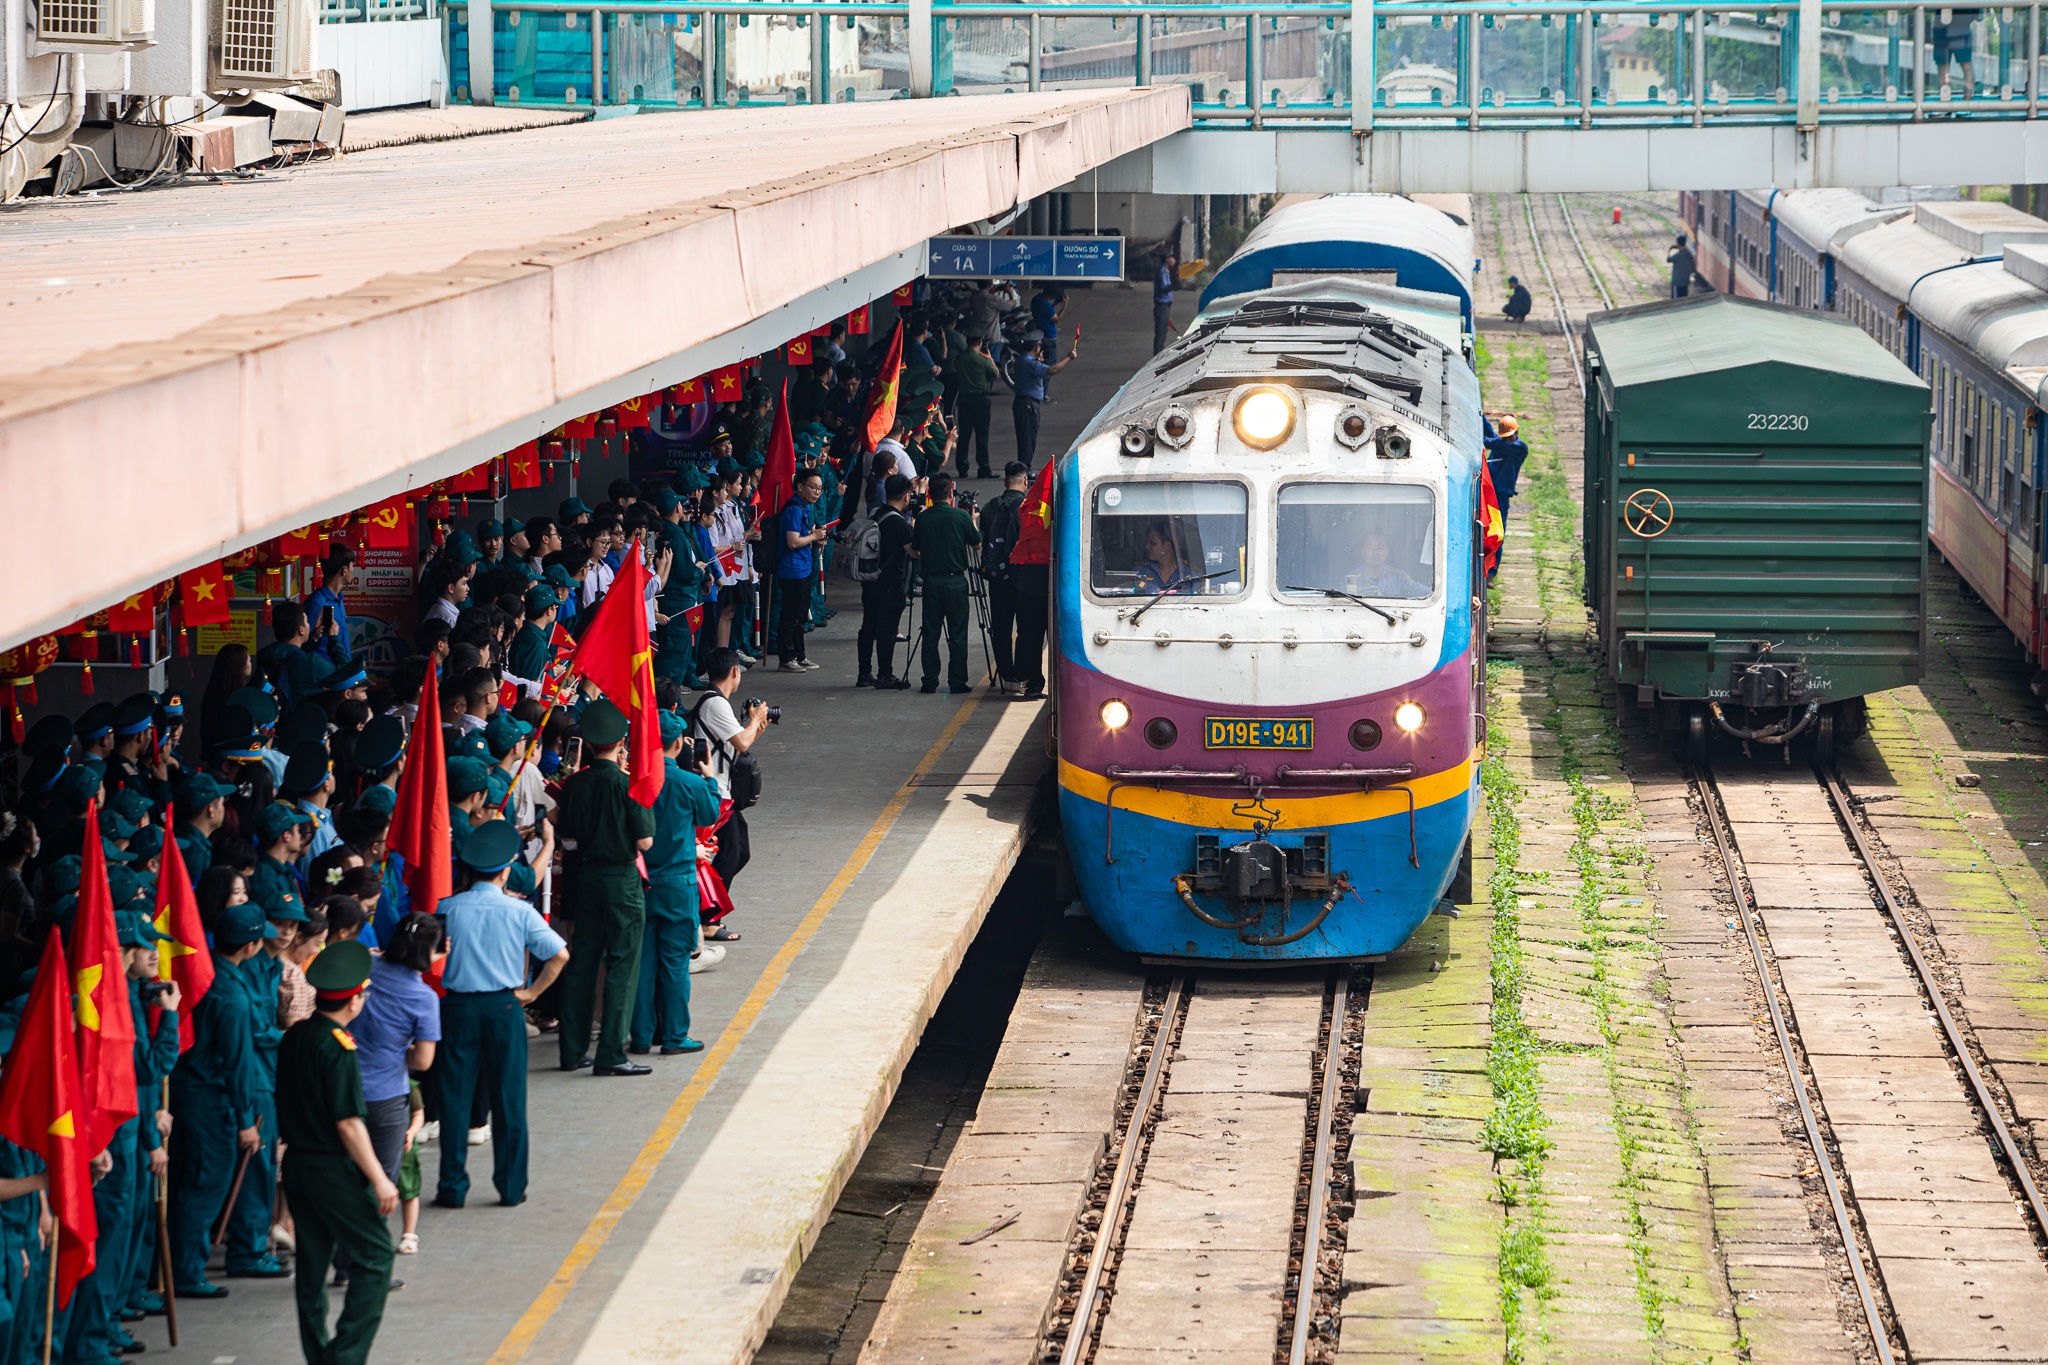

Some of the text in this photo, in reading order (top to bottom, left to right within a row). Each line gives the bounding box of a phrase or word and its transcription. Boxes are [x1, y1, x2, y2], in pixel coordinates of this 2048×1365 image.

[953, 256, 975, 271] 1A
[1017, 261, 1025, 276] 1
[1077, 261, 1085, 276] 1
[1747, 413, 1809, 431] 232230
[667, 450, 698, 459] TPBank
[1211, 722, 1307, 745] D19E-941
